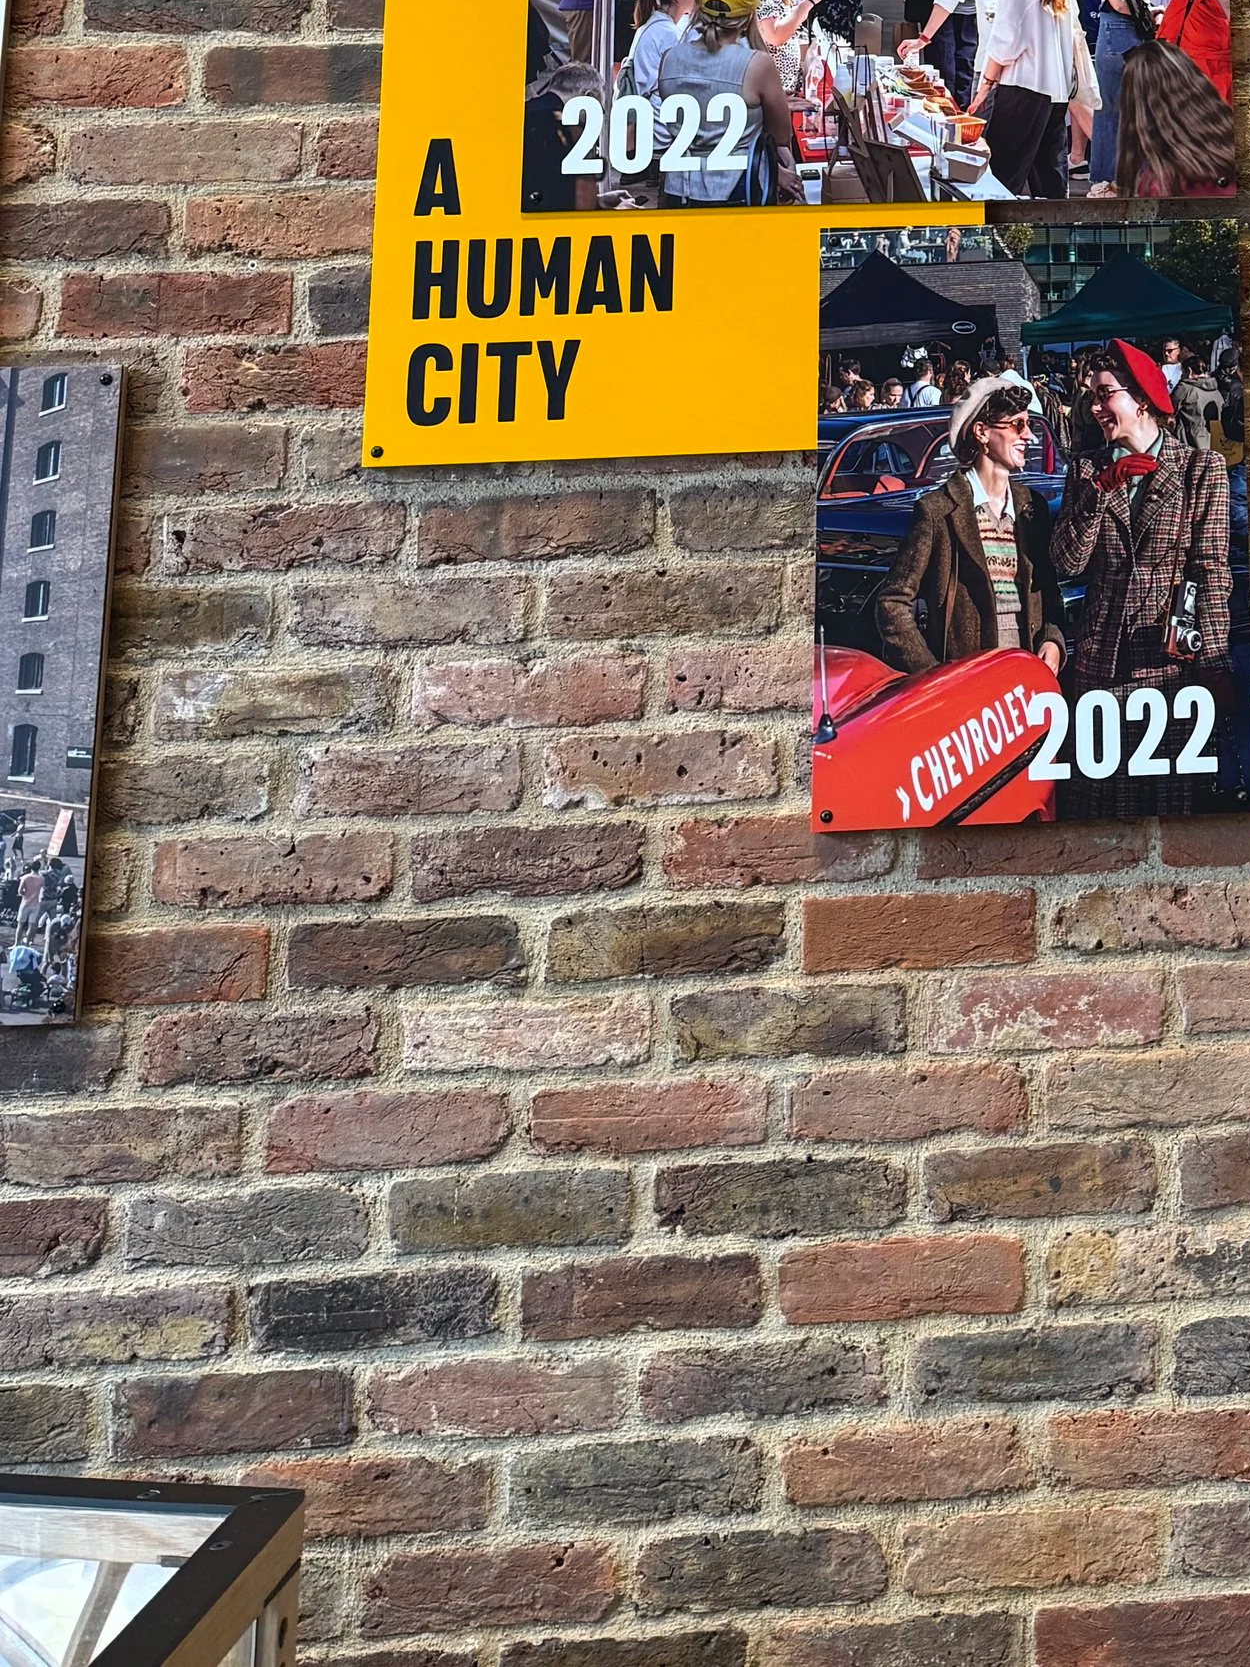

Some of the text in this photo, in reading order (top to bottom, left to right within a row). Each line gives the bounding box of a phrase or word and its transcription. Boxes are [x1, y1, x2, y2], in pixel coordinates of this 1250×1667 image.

[560, 91, 749, 175] 2022
[413, 137, 462, 217] A
[411, 233, 675, 320] HUMAN
[406, 339, 582, 427] CITY
[909, 683, 1031, 813] CHEVROLET
[1027, 684, 1219, 782] 2022
